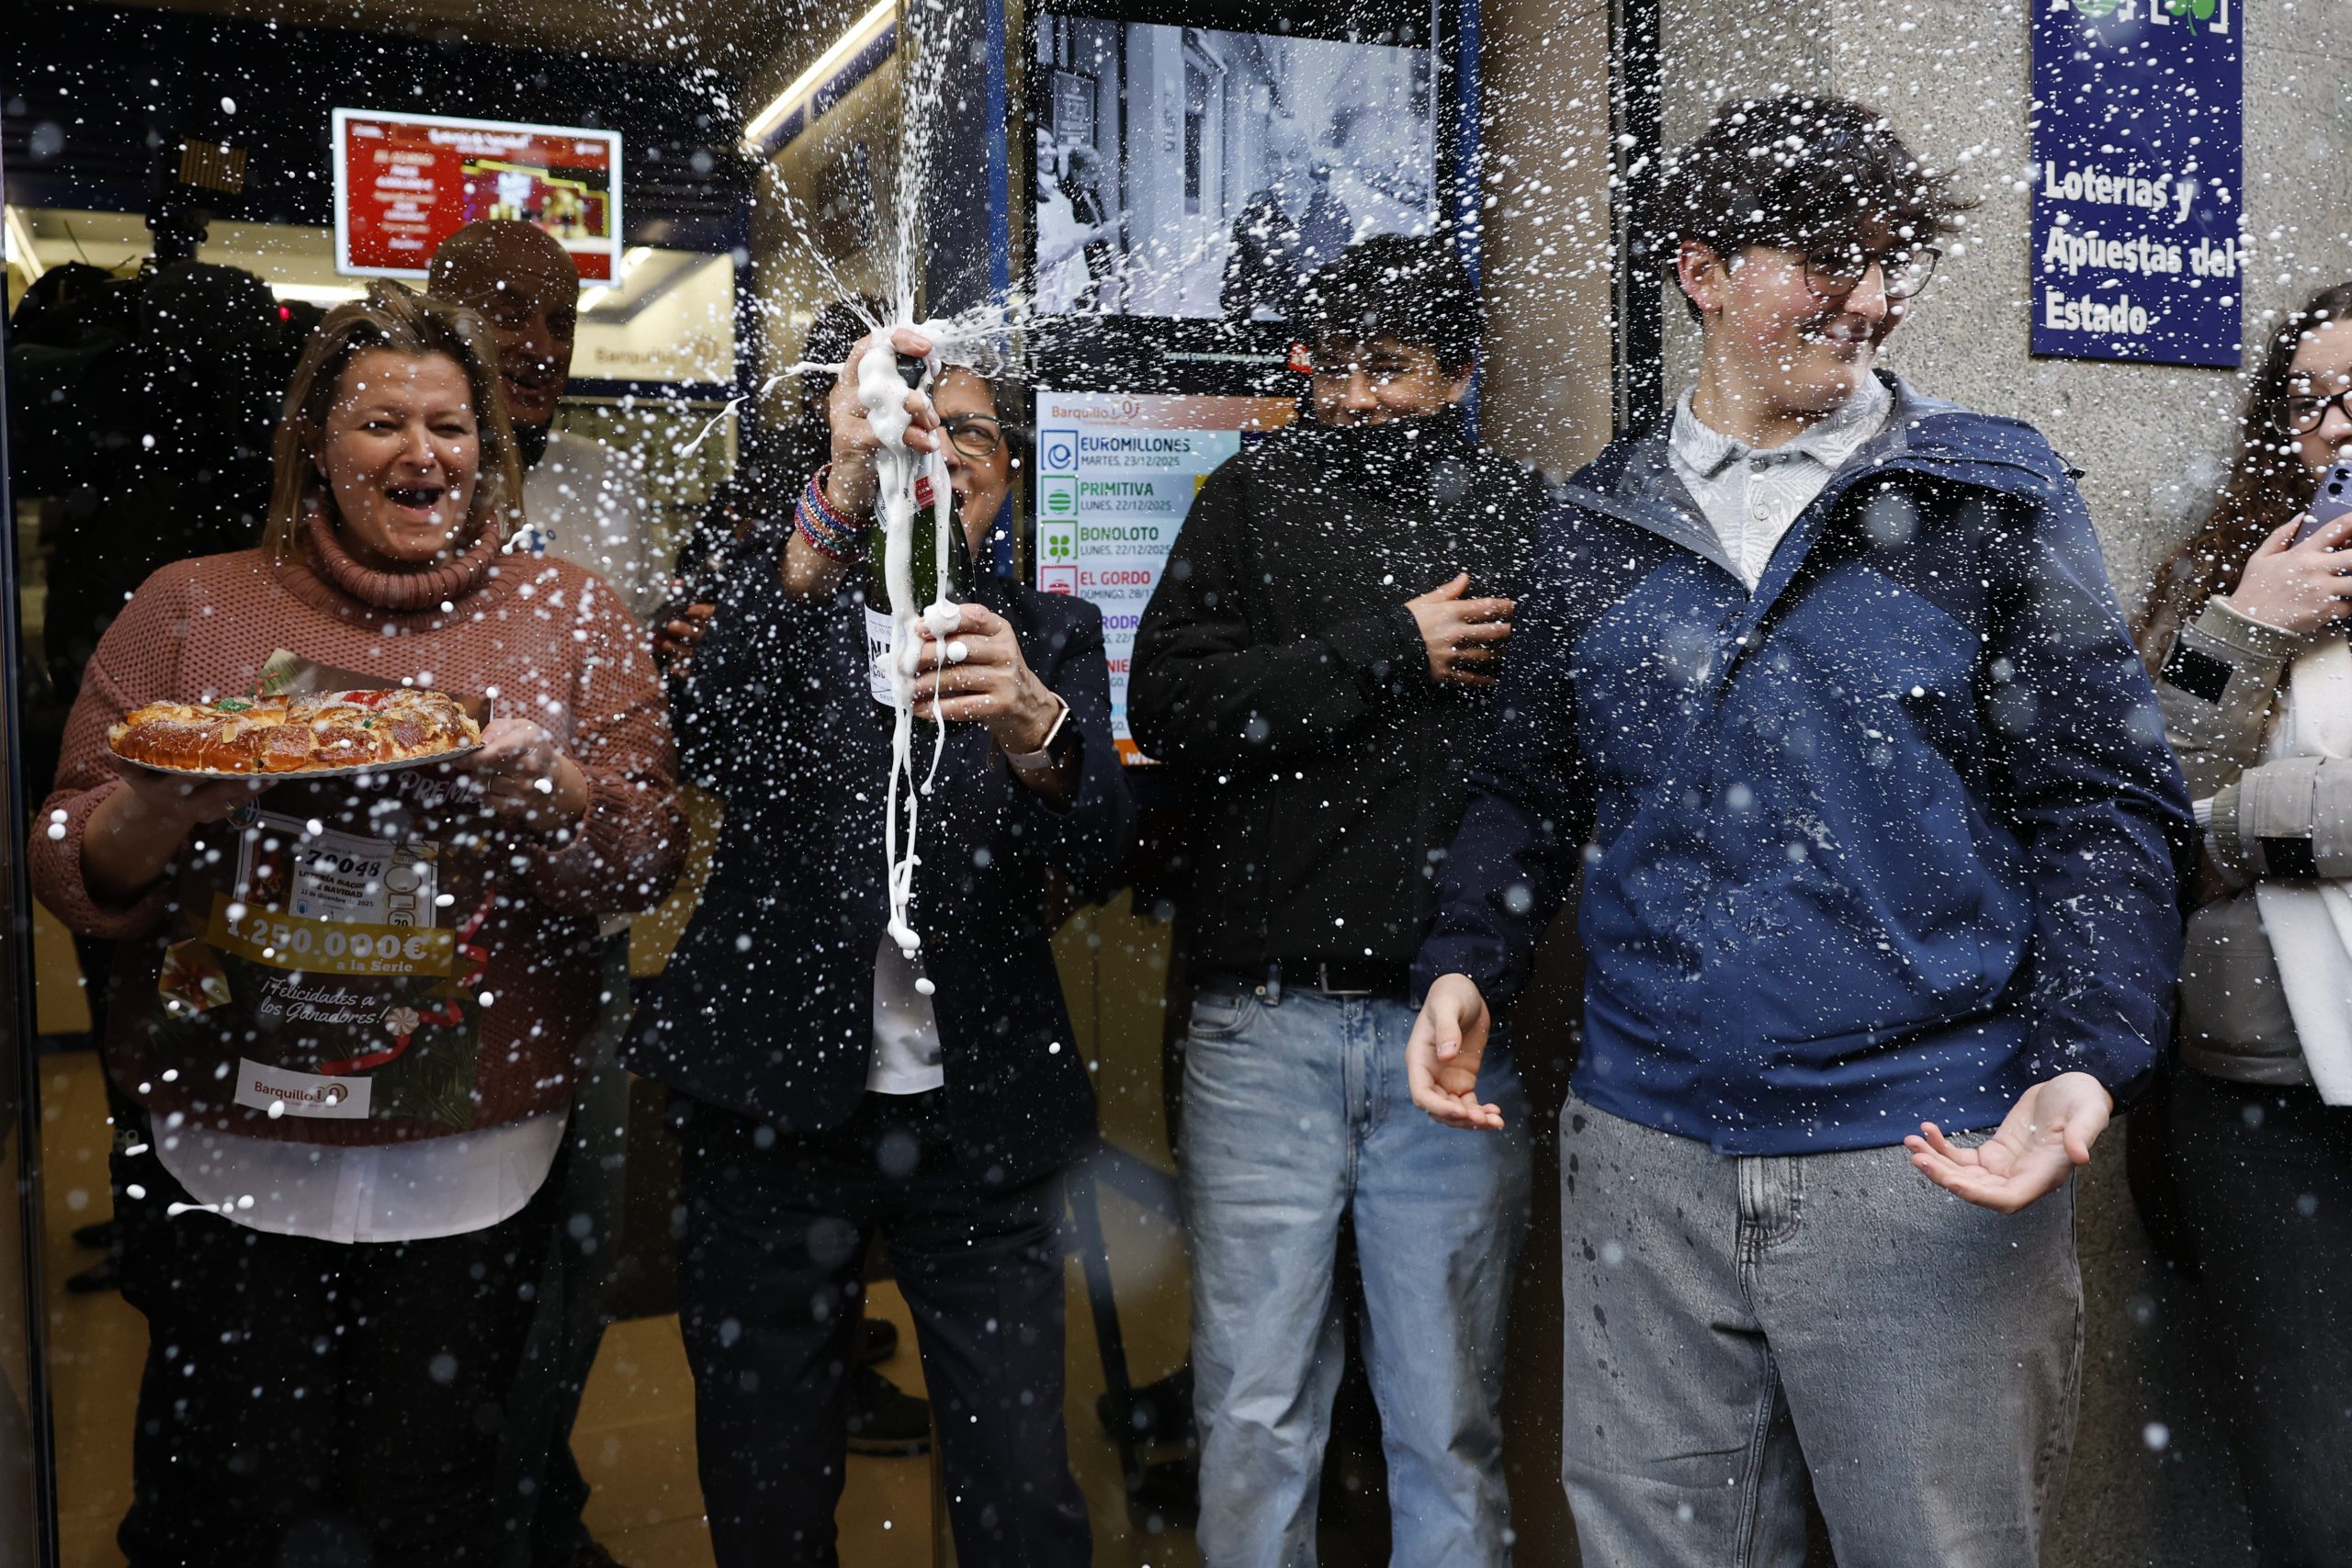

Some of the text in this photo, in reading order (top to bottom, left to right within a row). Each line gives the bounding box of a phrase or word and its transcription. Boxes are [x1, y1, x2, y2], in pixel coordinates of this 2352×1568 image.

[2046, 160, 2195, 222] Loterías y
[2045, 226, 2236, 277] Apuestas del
[2045, 290, 2148, 335] Estado
[1051, 406, 1109, 421] Barquillo
[1080, 436, 1192, 453] EUROMILLONES
[1080, 482, 1155, 497] PRIMITIVA
[1080, 527, 1159, 541] BONOLOTO
[1080, 571, 1151, 585] EL GORDO
[317, 892, 346, 904] diciembre
[323, 884, 364, 897] NAVIDAD
[227, 919, 428, 960] 1.250.000€
[336, 960, 413, 973] a la Serie
[361, 995, 375, 1007] a
[260, 995, 390, 1024] los Ganadores!
[254, 1080, 313, 1100] Barquillo
